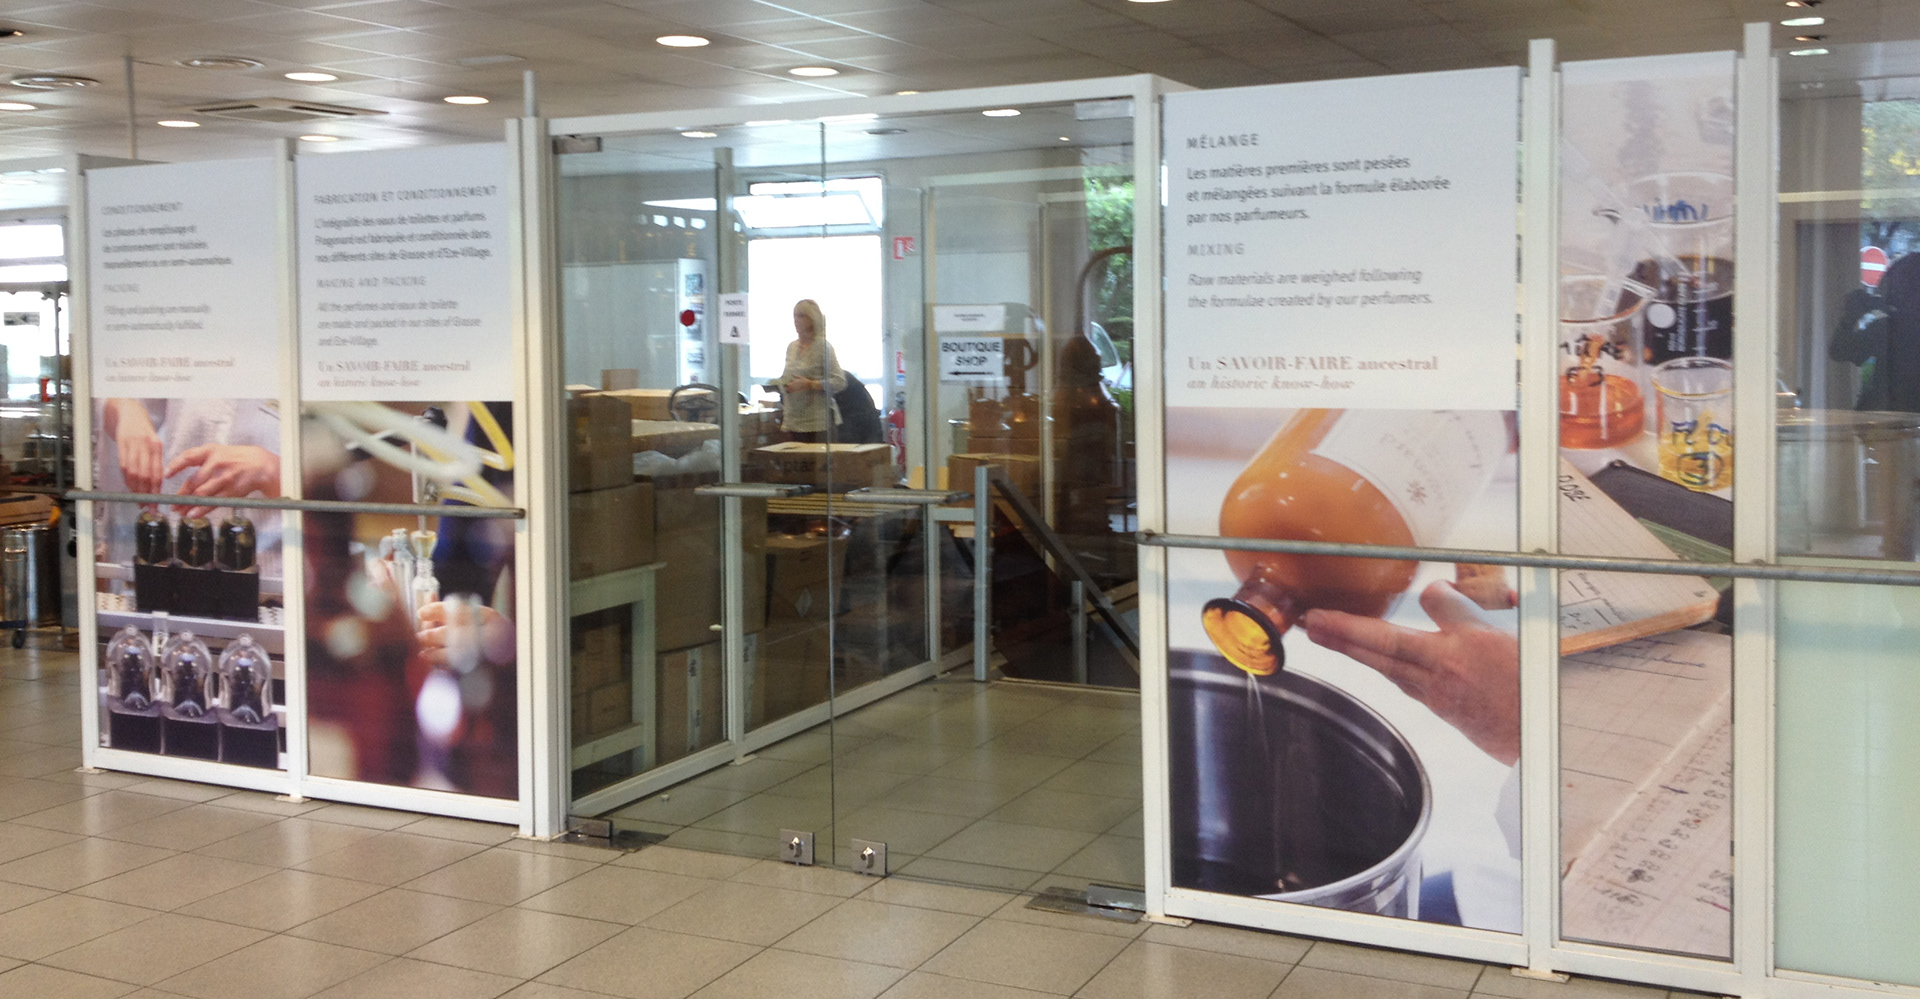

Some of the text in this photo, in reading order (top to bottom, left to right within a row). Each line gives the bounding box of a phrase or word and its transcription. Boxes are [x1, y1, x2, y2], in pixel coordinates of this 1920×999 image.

[1186, 133, 1259, 149] MÉLANGE
[1187, 157, 1411, 179] Les matières premières sont pesées
[381, 191, 393, 202] ET
[1186, 176, 1450, 204] et mélangées suivant la formule élaborée
[1186, 214, 1206, 226] par
[1209, 213, 1232, 222] nos
[1187, 243, 1244, 256] MIXING
[1187, 269, 1422, 286] Raw materials are weighed following
[1187, 295, 1207, 307] the
[1210, 294, 1264, 307] formulae
[1266, 293, 1314, 306] created
[1316, 293, 1332, 308] by
[1334, 296, 1358, 305] our
[942, 342, 1001, 352] BOUTIQUE
[955, 356, 987, 366] SHOP
[1188, 356, 1438, 370] Un SAVOIR-FAIRE ancestral
[1187, 375, 1355, 389] an historic know-how
